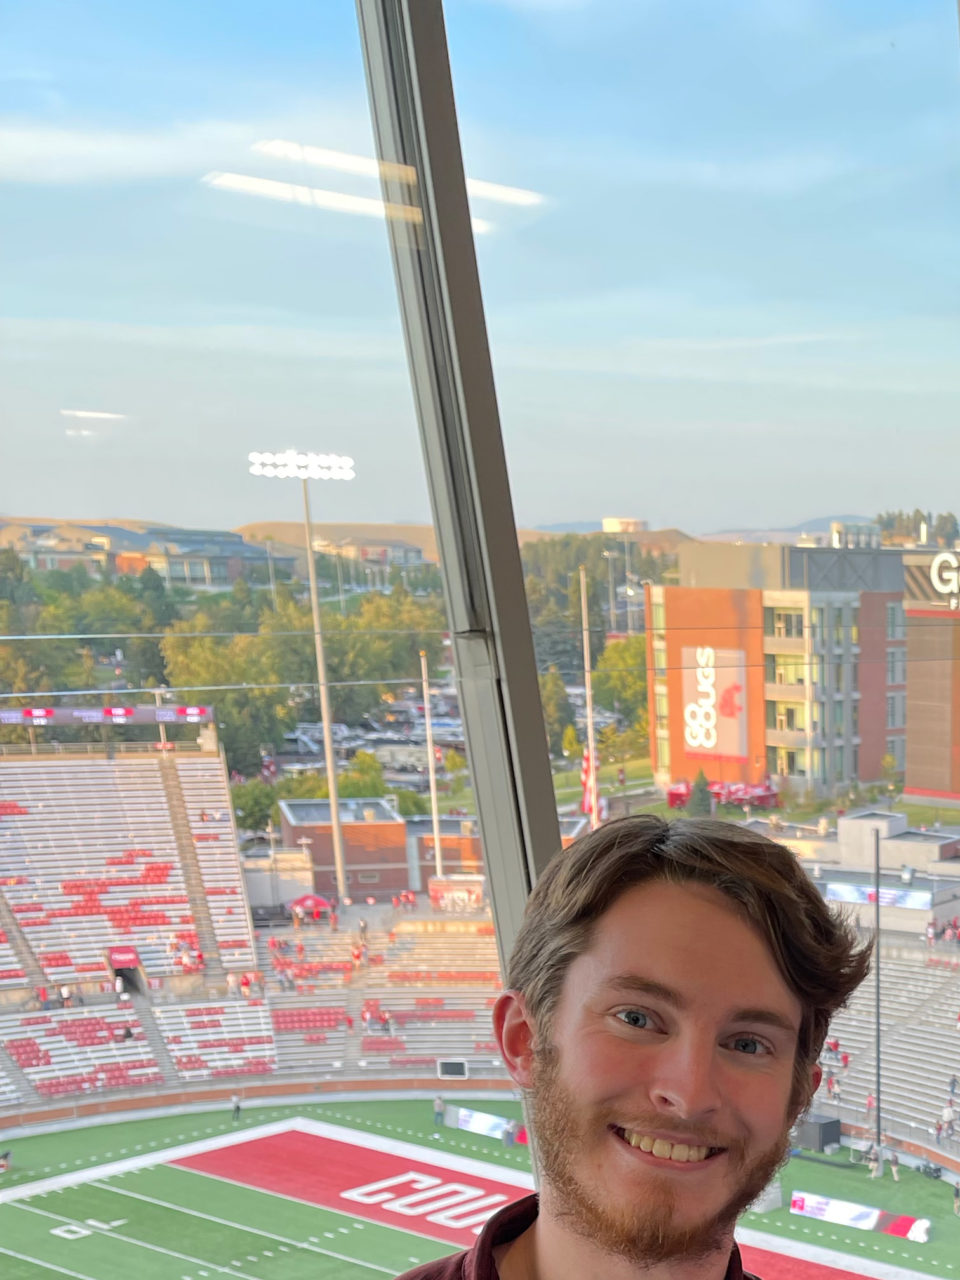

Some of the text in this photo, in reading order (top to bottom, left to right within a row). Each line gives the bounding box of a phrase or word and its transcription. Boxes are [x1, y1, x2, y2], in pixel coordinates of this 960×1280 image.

[684, 702, 702, 747] GO
[695, 646, 718, 748] COUGS
[339, 1171, 508, 1236] COU
